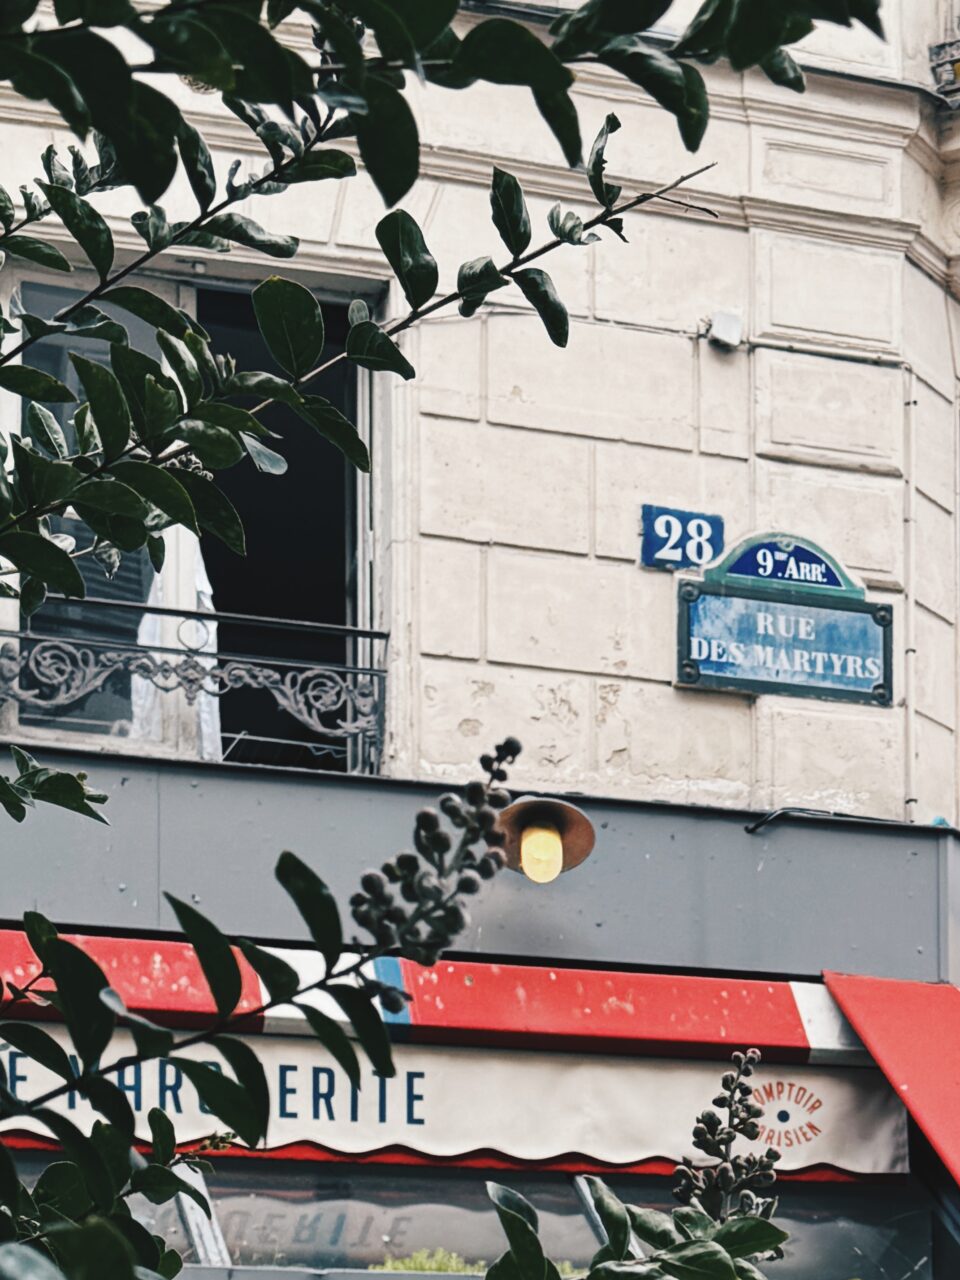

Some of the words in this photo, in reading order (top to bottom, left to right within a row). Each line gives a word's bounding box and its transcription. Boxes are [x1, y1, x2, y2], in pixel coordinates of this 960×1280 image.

[654, 514, 714, 564] 28
[756, 611, 816, 641] RUE
[689, 637, 746, 665] DES
[753, 645, 881, 680] MARTYRS
[752, 1081, 824, 1115] OMPTOIR
